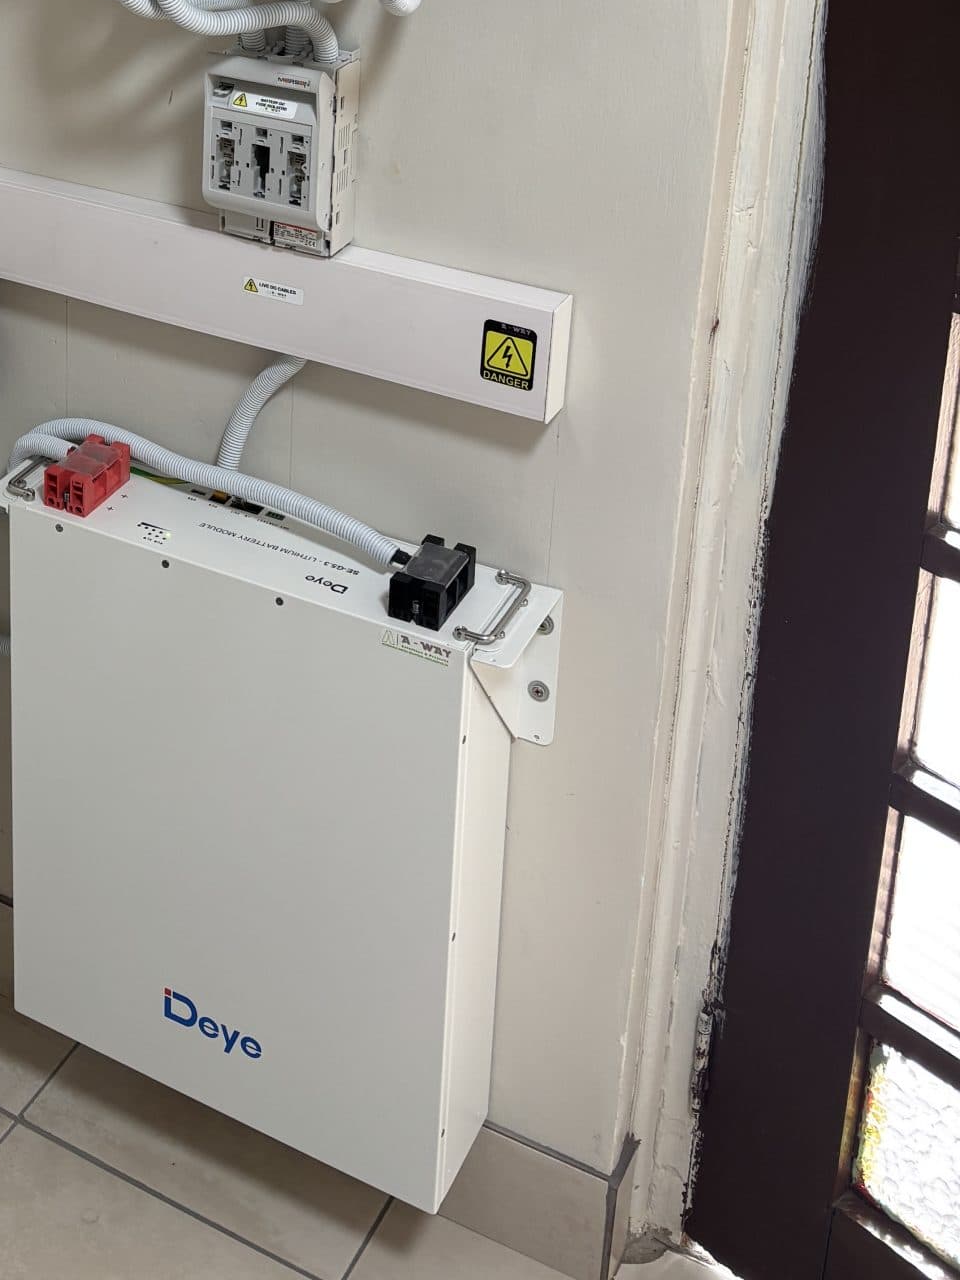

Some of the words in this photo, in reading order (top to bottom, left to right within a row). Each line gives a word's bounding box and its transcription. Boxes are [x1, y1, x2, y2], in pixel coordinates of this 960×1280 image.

[483, 370, 529, 390] DANGER
[198, 522, 237, 538] MODULE
[238, 535, 279, 551] BATTERY
[280, 547, 318, 563] LITHIUM
[323, 561, 360, 576] SE-G5.3
[164, 986, 262, 1059] Deye
